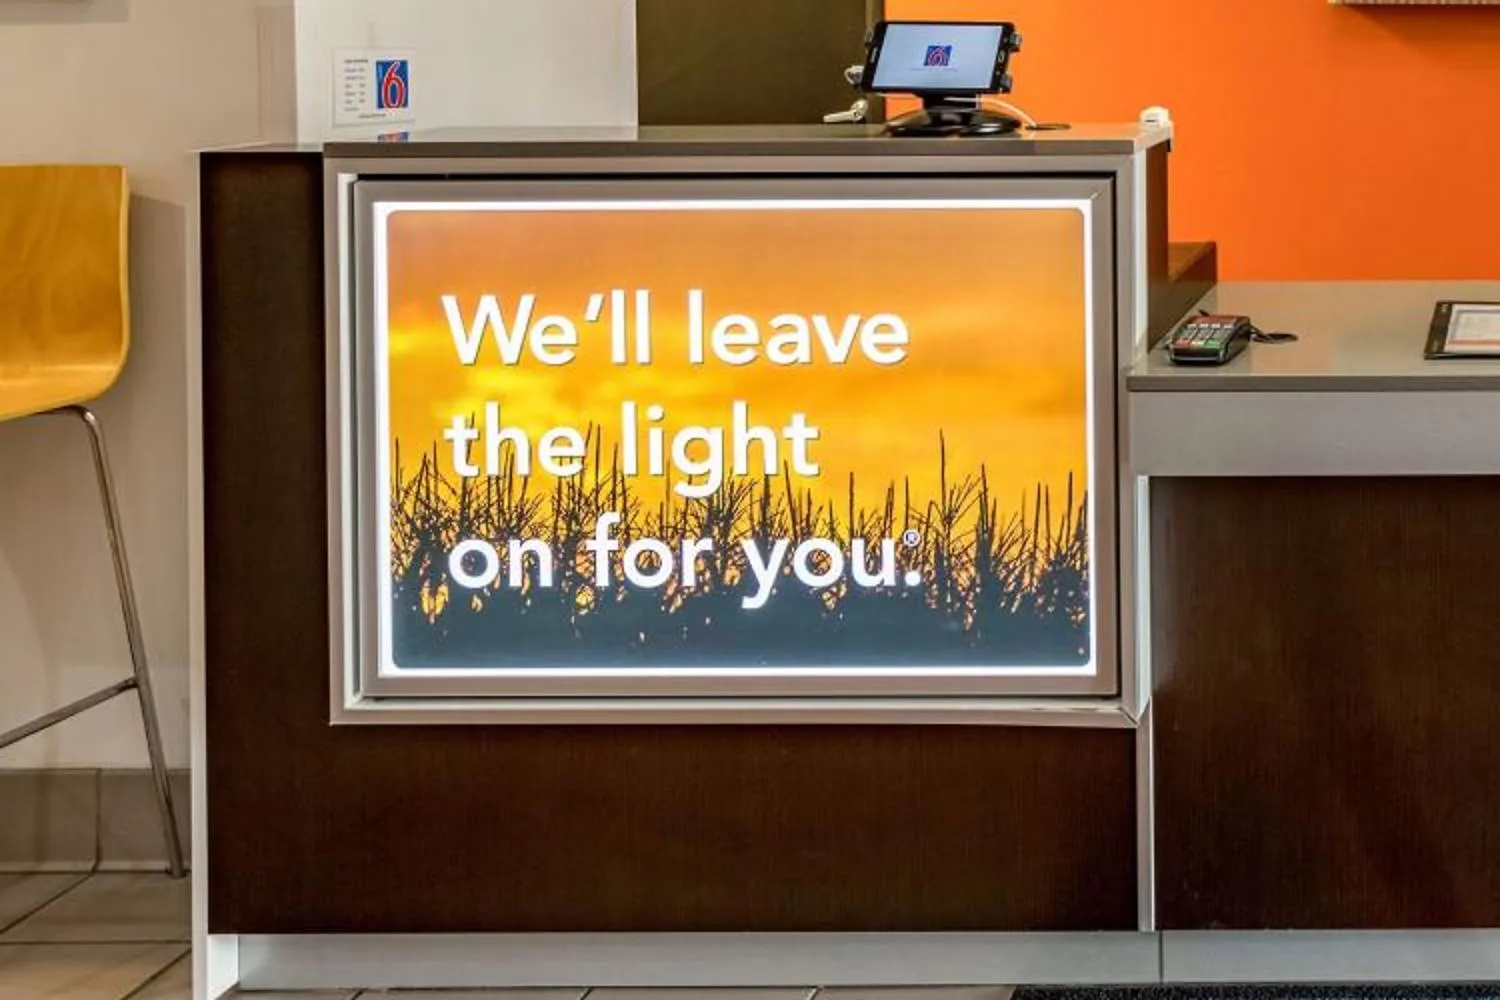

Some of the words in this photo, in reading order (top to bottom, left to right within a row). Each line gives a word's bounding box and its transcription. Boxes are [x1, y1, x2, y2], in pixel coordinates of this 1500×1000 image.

[382, 61, 406, 108] 6
[441, 289, 651, 366] We'll
[688, 289, 910, 366] leave
[443, 401, 587, 478] the
[621, 401, 821, 498] light
[447, 537, 553, 589] on
[587, 513, 712, 589] for
